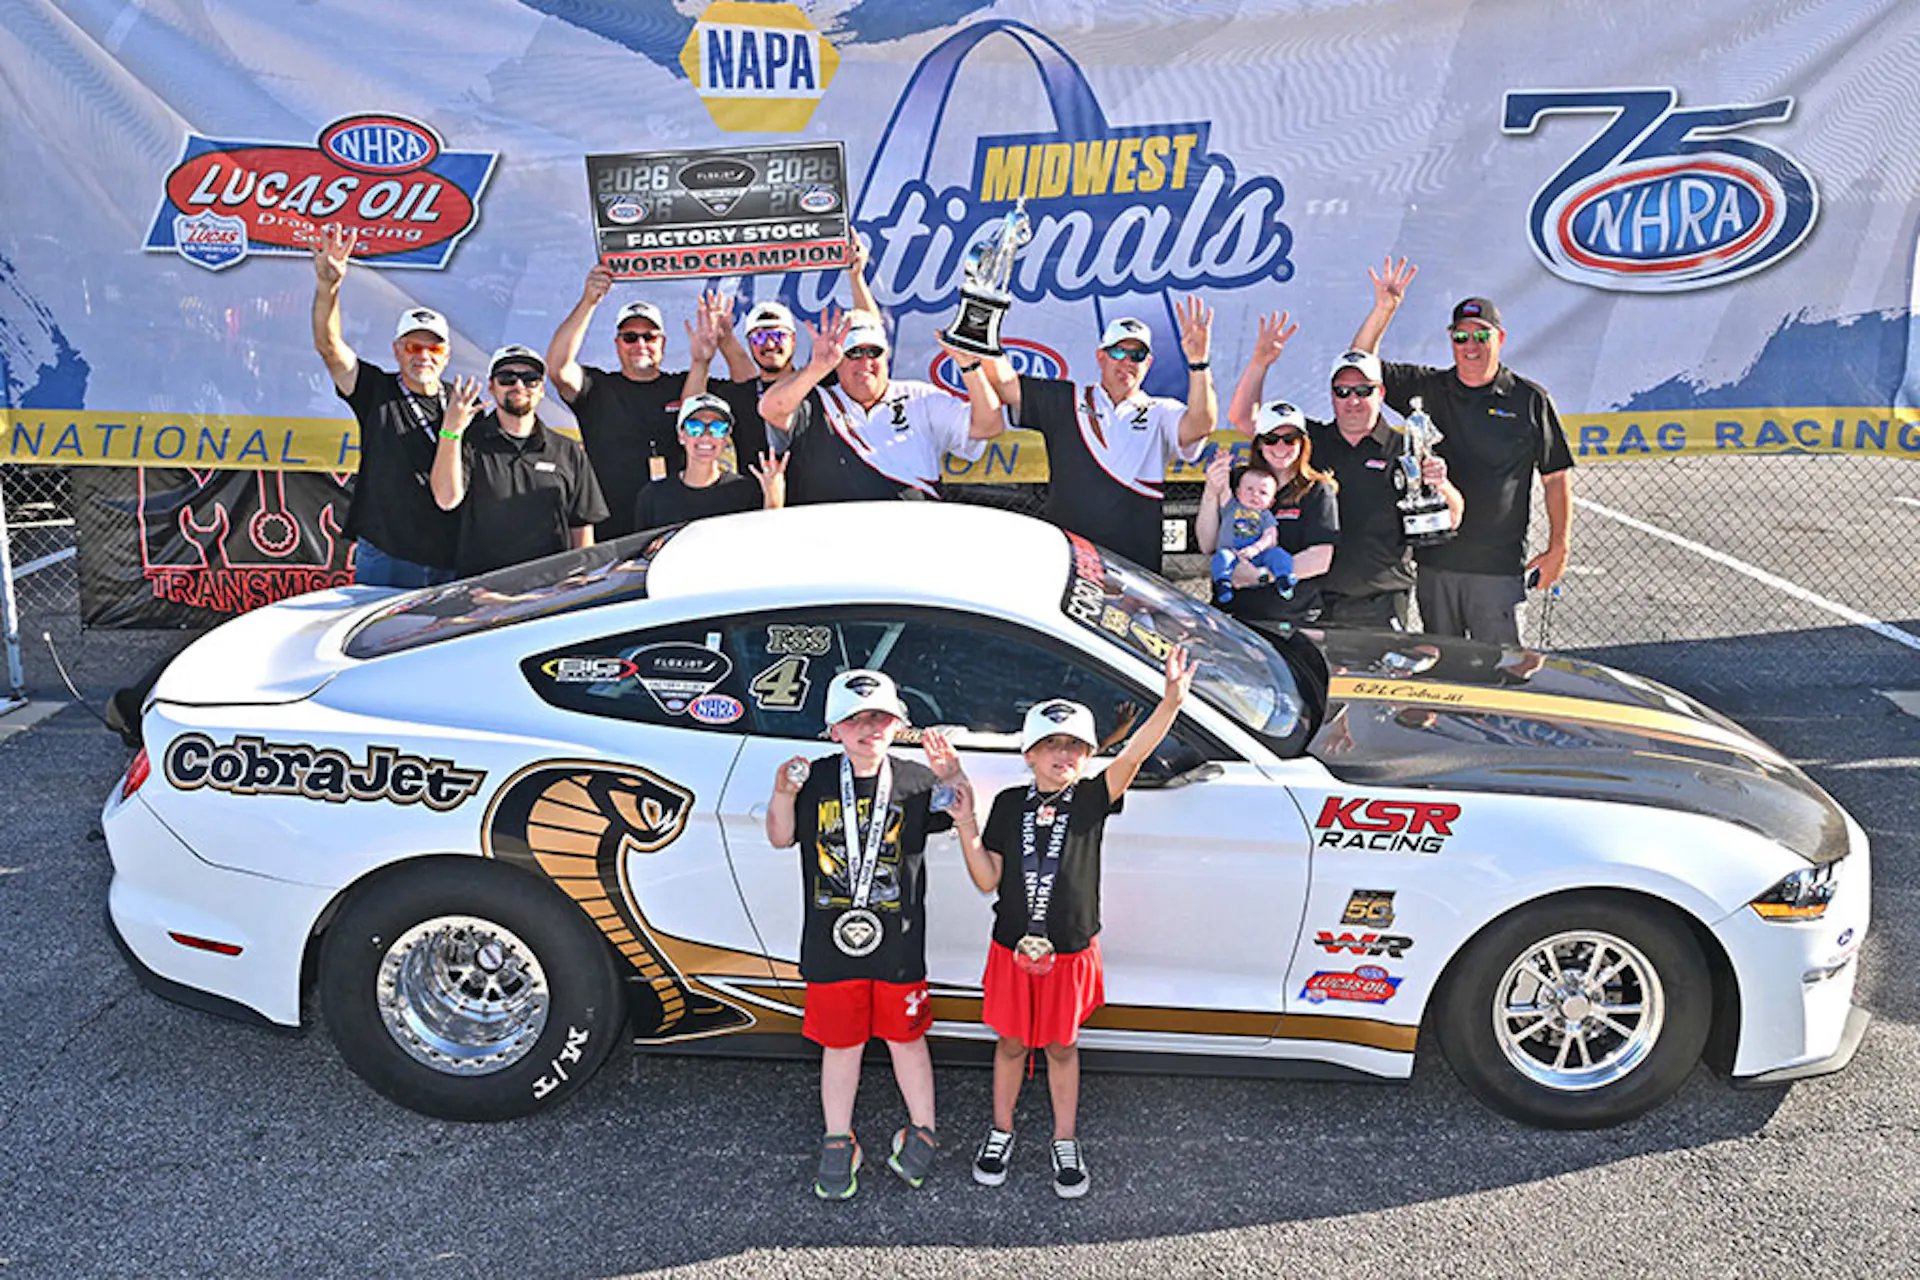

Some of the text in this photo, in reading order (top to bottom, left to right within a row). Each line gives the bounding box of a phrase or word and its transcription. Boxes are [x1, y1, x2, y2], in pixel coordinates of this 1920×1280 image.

[708, 30, 815, 89] NAPA
[341, 128, 421, 163] NHRA
[599, 164, 669, 192] 2026
[767, 156, 837, 184] 2026
[980, 134, 1198, 203] MIDWEST
[188, 164, 443, 222] LUCAS OIL
[1502, 88, 1819, 291] 75
[257, 212, 314, 232] Drag
[627, 222, 820, 248] FACTORY STOCK
[1588, 179, 1743, 252] NHRA
[608, 245, 843, 274] WORLD CHAMPION
[11, 421, 307, 464] NATIONAL
[1578, 419, 1920, 456] RAG RACING
[752, 657, 805, 708] 4
[699, 699, 735, 719] NHRA
[1023, 811, 1036, 856] NHRA
[1047, 813, 1069, 858] NHRA
[1315, 796, 1461, 835] KSR
[1319, 831, 1445, 854] RACING
[1032, 873, 1054, 921] NHRA
[1312, 977, 1364, 991] LUCAS
[1363, 981, 1388, 994] OIL
[532, 1026, 589, 1099] M/T
